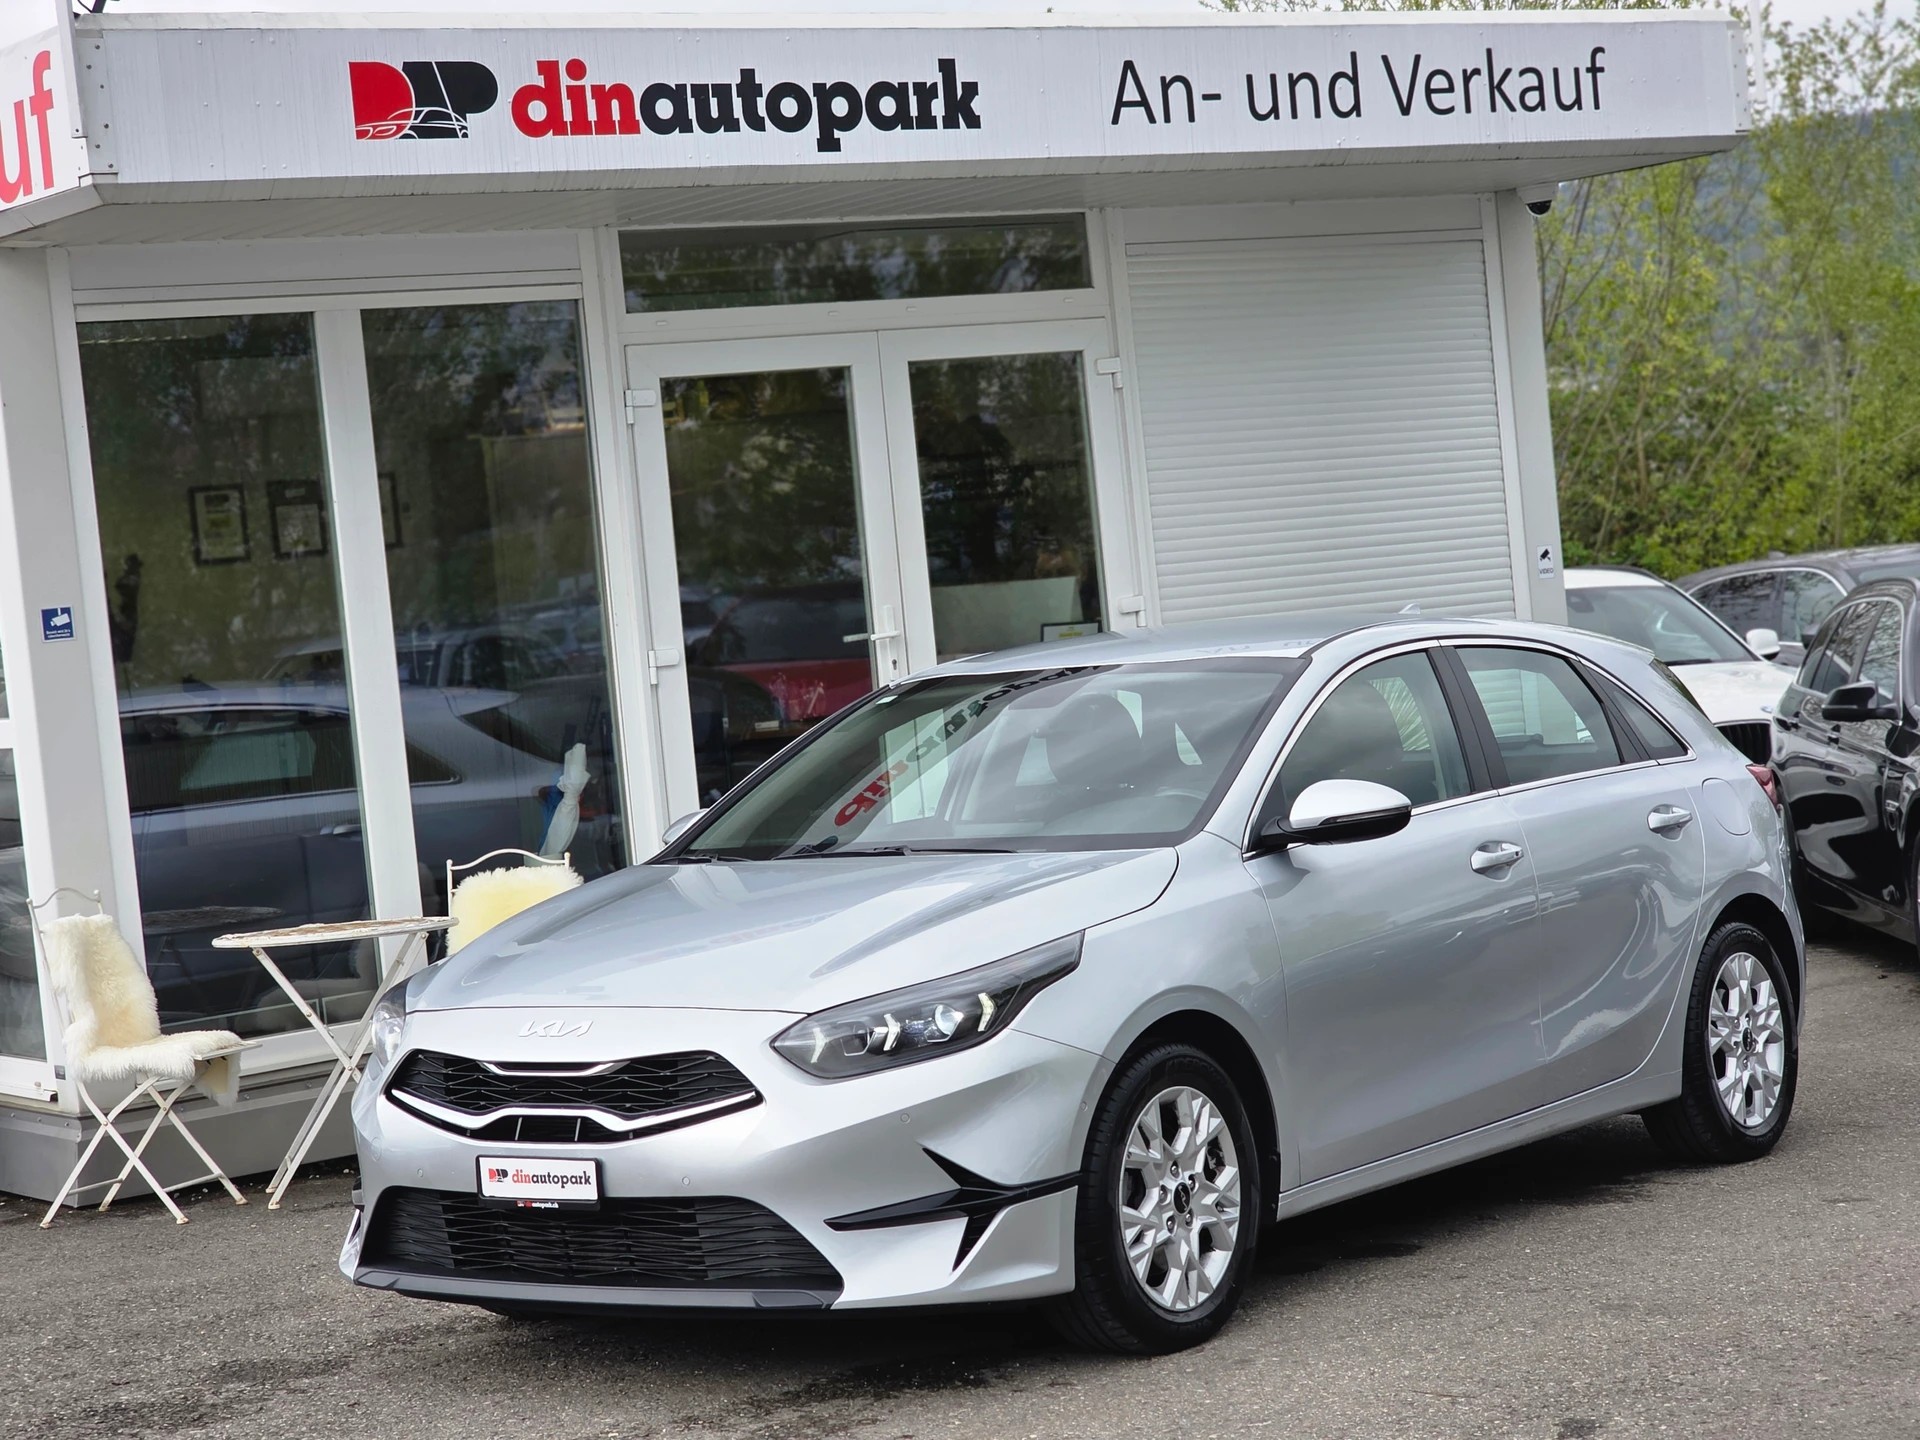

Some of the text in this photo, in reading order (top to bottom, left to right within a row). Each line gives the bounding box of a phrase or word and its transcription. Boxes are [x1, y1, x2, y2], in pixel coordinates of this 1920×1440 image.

[511, 57, 982, 152] dinautopark
[1111, 46, 1606, 125] An- und Verkauf
[511, 1169, 592, 1189] dinautopark
